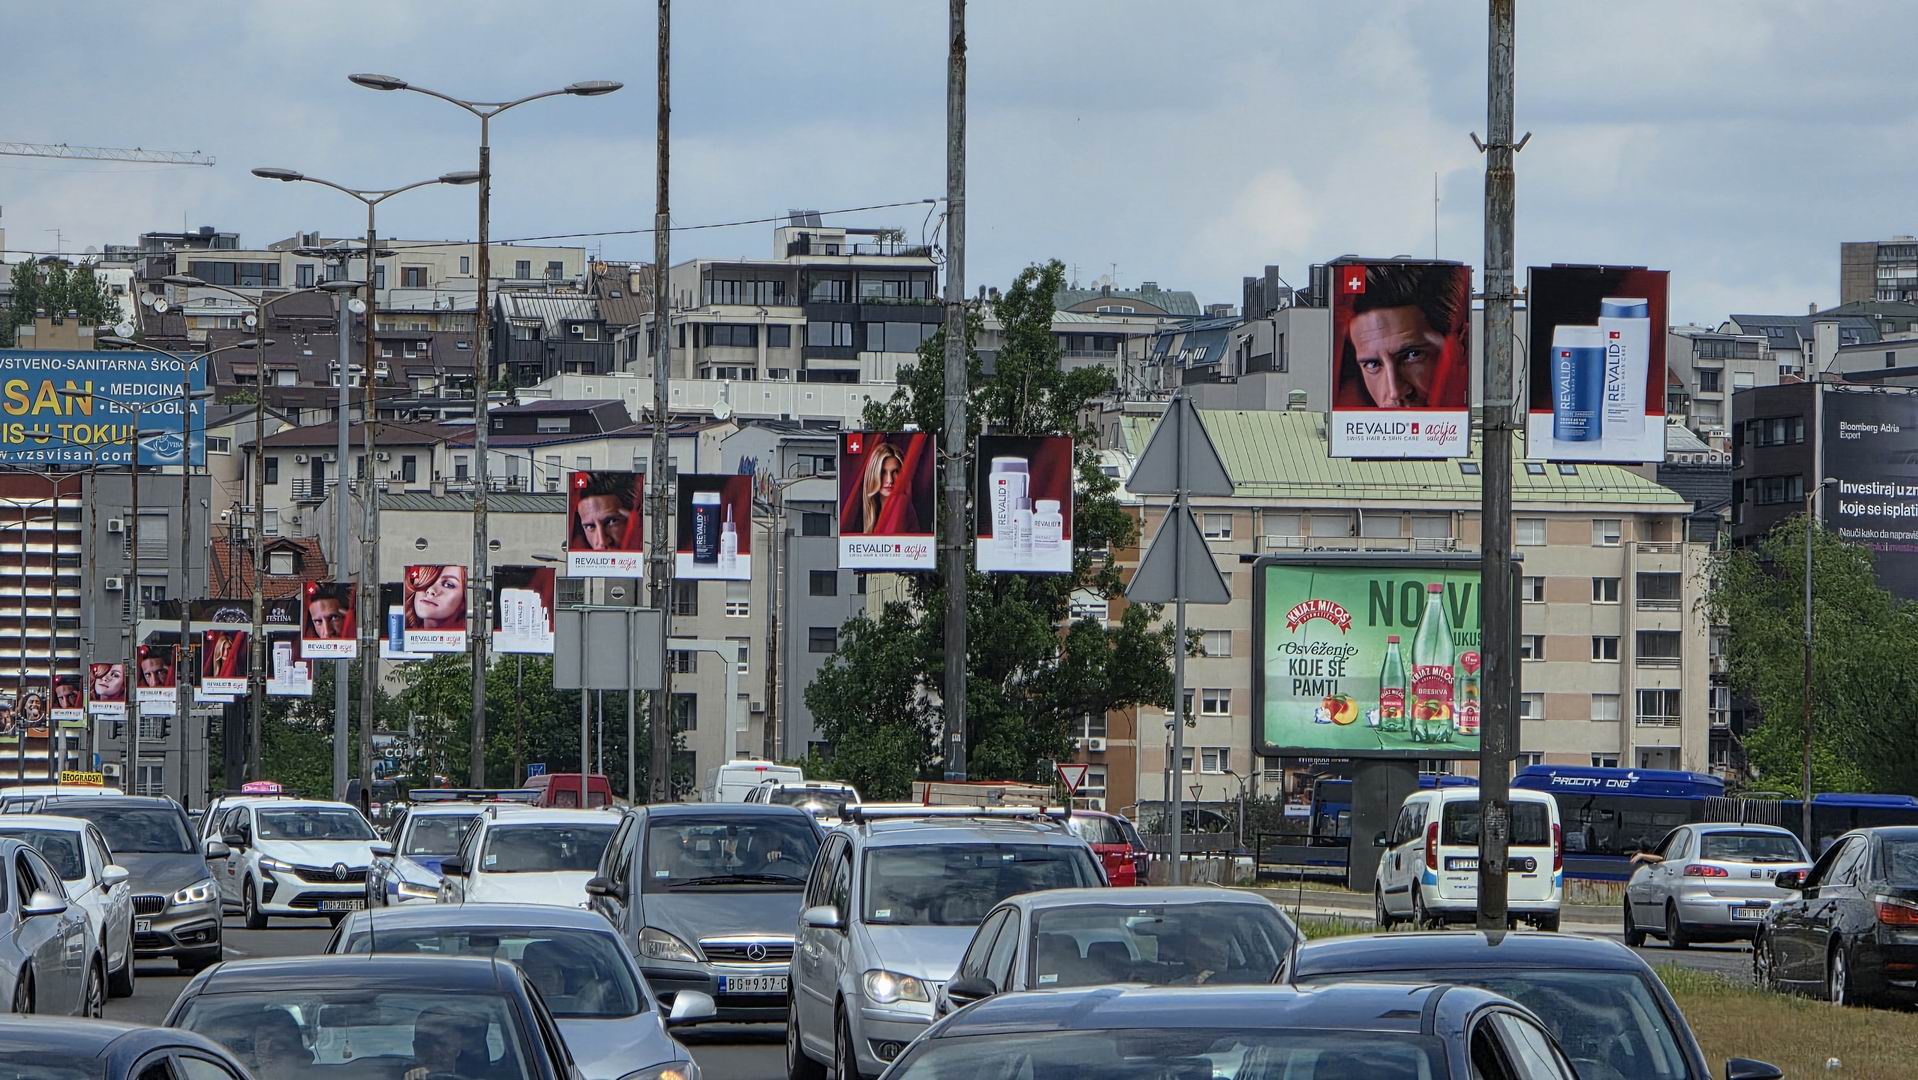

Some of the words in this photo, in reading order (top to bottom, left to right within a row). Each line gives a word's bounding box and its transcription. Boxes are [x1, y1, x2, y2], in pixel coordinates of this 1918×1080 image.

[1608, 344, 1620, 402] REVALID
[3, 378, 92, 416] SAN
[110, 383, 184, 396] MEDICINA
[1346, 422, 1406, 435] REVALID
[1425, 421, 1457, 446] acija
[1840, 422, 1878, 434] Bloomberg
[1880, 424, 1900, 433] Adria
[1840, 431, 1861, 439] Expert
[1840, 480, 1895, 498] Investiraj
[1897, 486, 1905, 496] u
[1840, 500, 1866, 517] koje
[1867, 505, 1882, 516] se
[1883, 502, 1918, 519] isplati
[1840, 527, 1861, 538] Nauči
[1861, 528, 1880, 538] kako
[1880, 529, 1889, 539] da
[849, 544, 892, 553] REVALID
[1287, 601, 1316, 622] KNJAZ
[1277, 641, 1359, 662] Osveženje
[1289, 658, 1323, 676] KOJE
[1328, 659, 1346, 677] SE
[1293, 678, 1338, 697] PAMTI
[62, 772, 102, 783] BEOGRADSKI
[1551, 776, 1602, 787] PROCITY
[1605, 779, 1631, 788] CNG
[728, 978, 743, 990] BG
